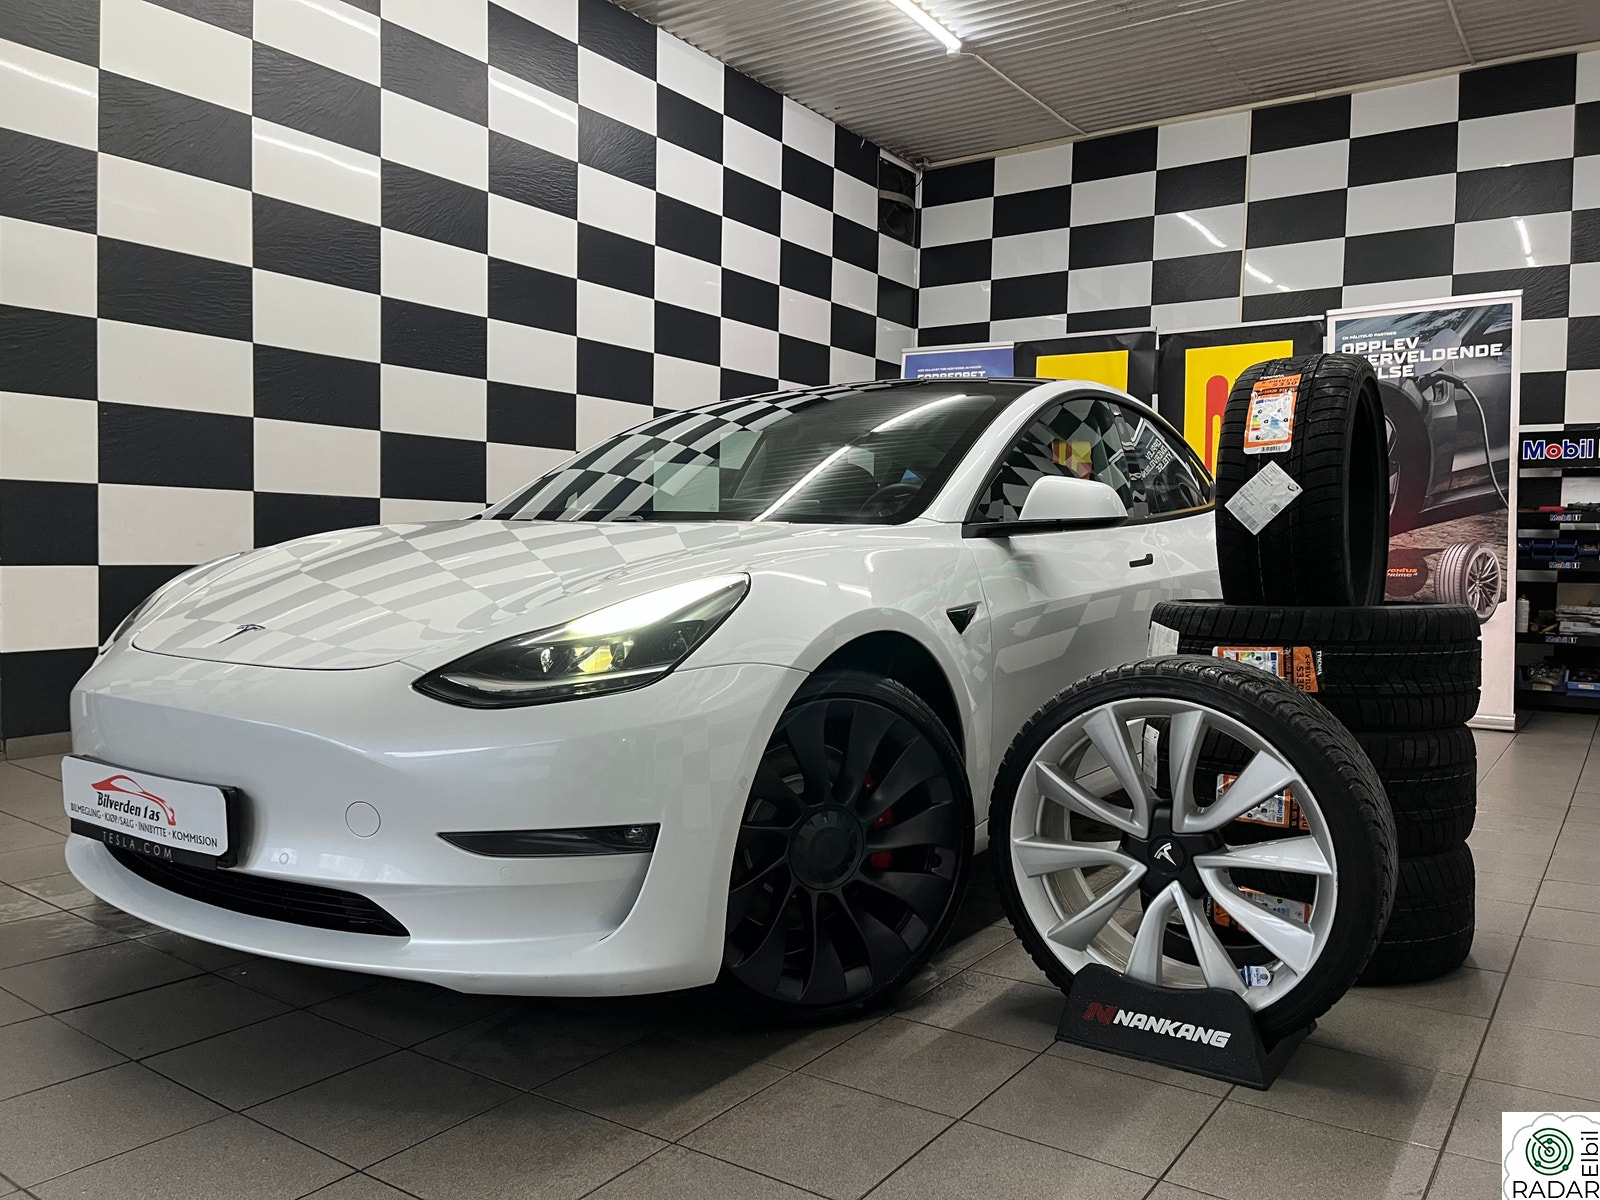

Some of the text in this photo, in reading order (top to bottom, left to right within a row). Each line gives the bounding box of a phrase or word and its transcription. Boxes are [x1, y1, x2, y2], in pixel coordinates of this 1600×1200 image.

[1341, 336, 1420, 354] OPPLEV
[1363, 343, 1504, 367] ERVELDENDE
[1522, 438, 1594, 460] Mobil
[70, 802, 101, 819] BILMEGLING
[138, 824, 167, 837] INNBYTTE
[96, 792, 141, 818] Bilverden
[149, 810, 160, 822] as
[1113, 1009, 1232, 1048] NANKANG
